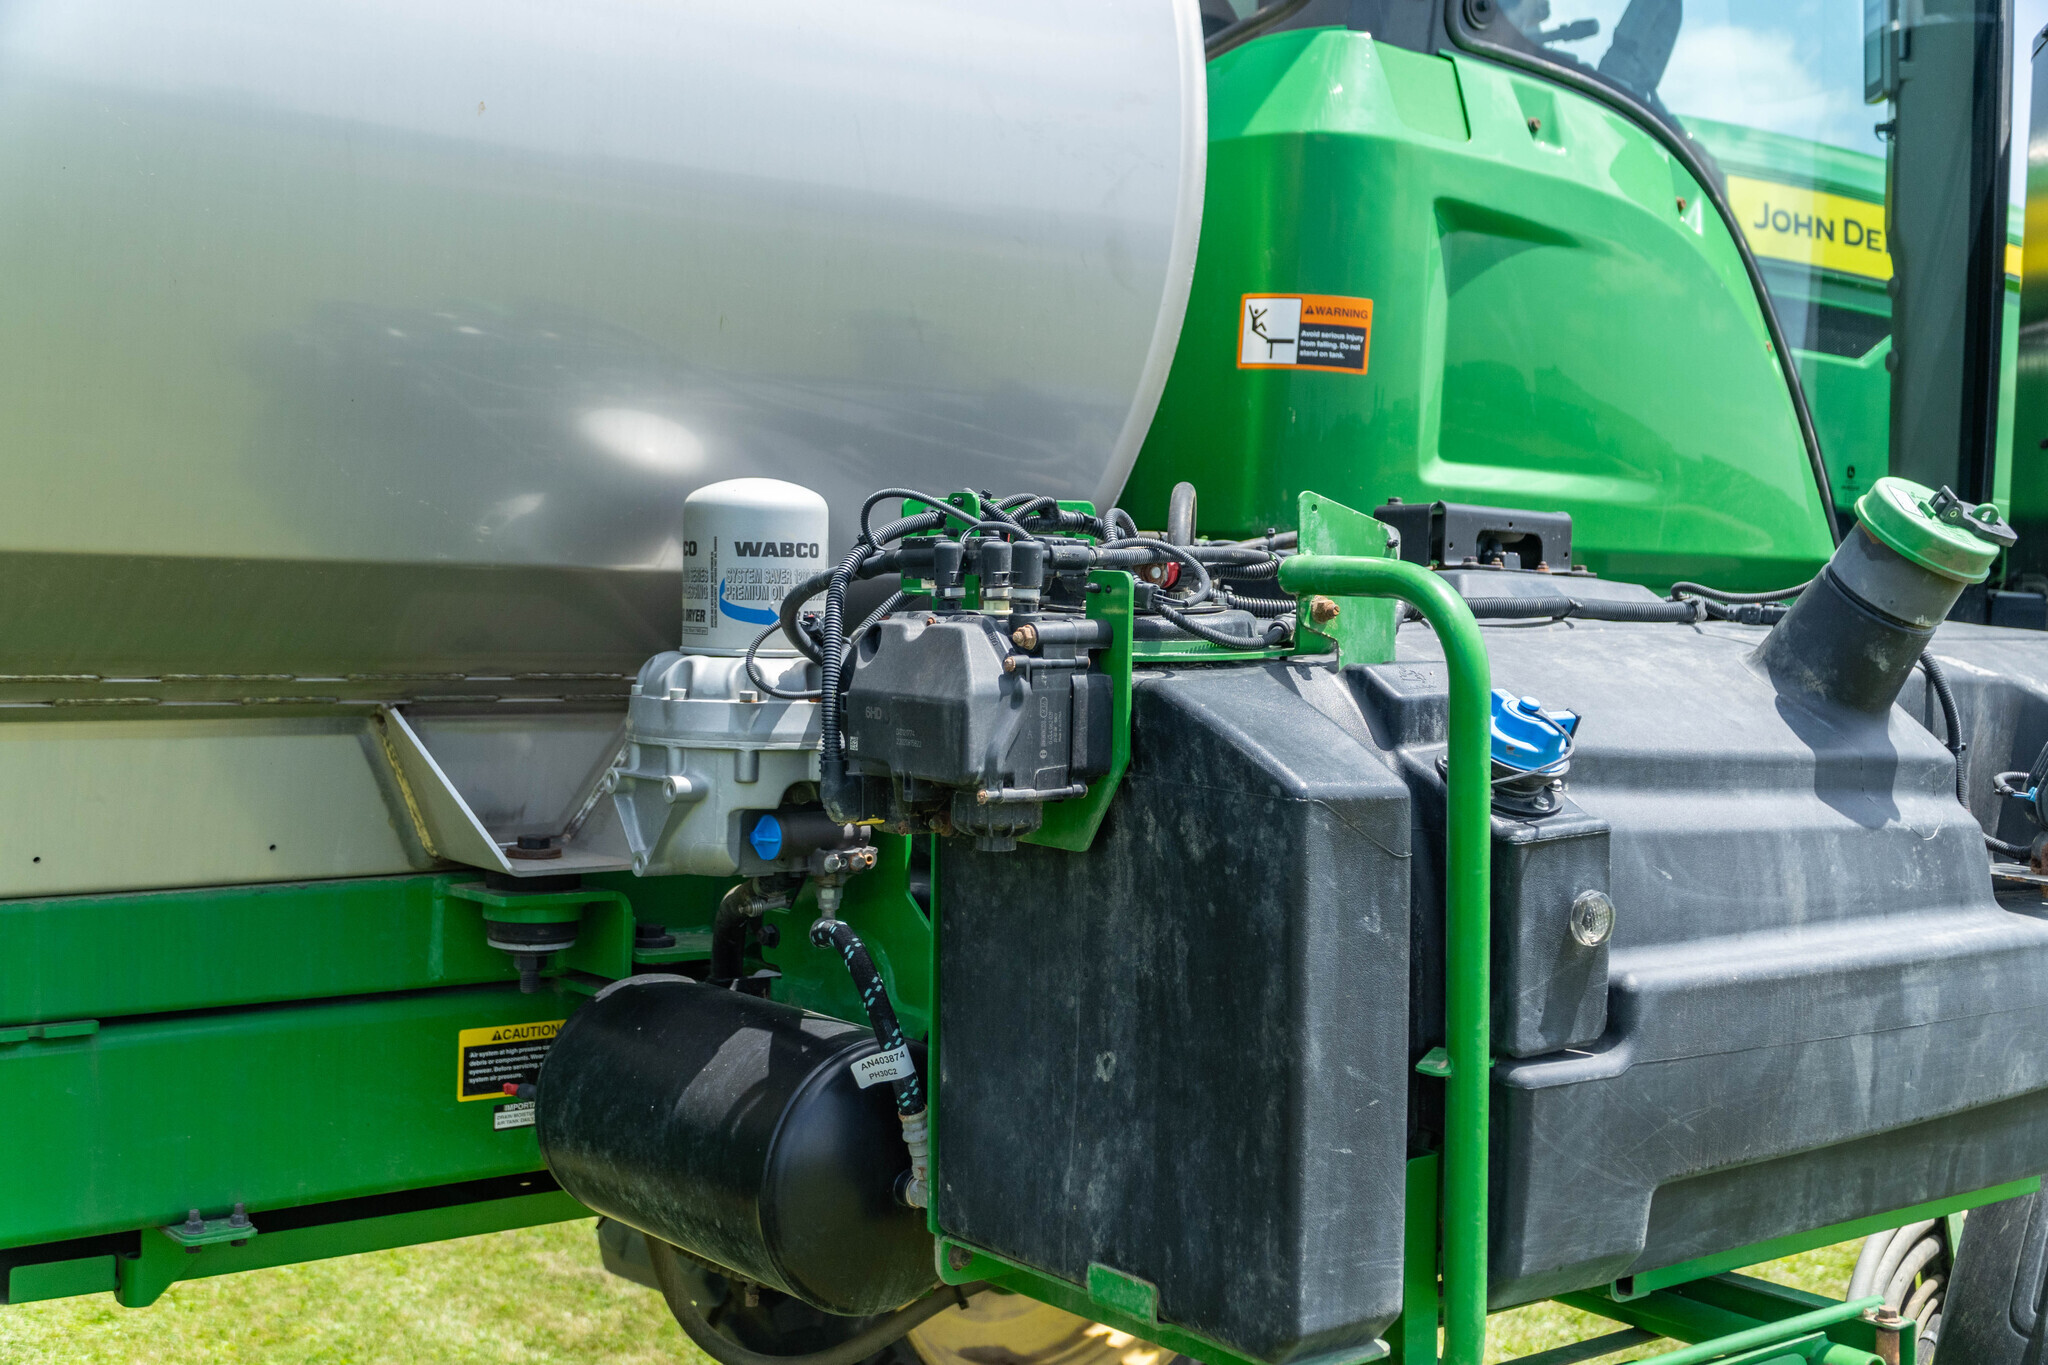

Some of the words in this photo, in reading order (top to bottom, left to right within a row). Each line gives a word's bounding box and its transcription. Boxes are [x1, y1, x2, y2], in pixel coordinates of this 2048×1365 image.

[1754, 202, 1834, 242] JOHN
[1844, 218, 1888, 253] DE
[1315, 306, 1368, 319] WARNING
[1301, 330, 1320, 338] Avoid
[1321, 331, 1345, 340] serious
[1346, 333, 1364, 343] injury
[734, 541, 819, 559] WABCO
[726, 567, 762, 584] SYSTEM
[765, 568, 792, 584] SAVER
[725, 584, 770, 601] PREMIUM
[772, 585, 785, 601] OIL
[503, 1023, 560, 1040] CAUTION
[479, 1050, 500, 1058] system
[506, 1047, 518, 1056] high
[519, 1045, 542, 1054] pressure
[861, 1051, 905, 1071] AN403874
[869, 1068, 898, 1080] PH30C2
